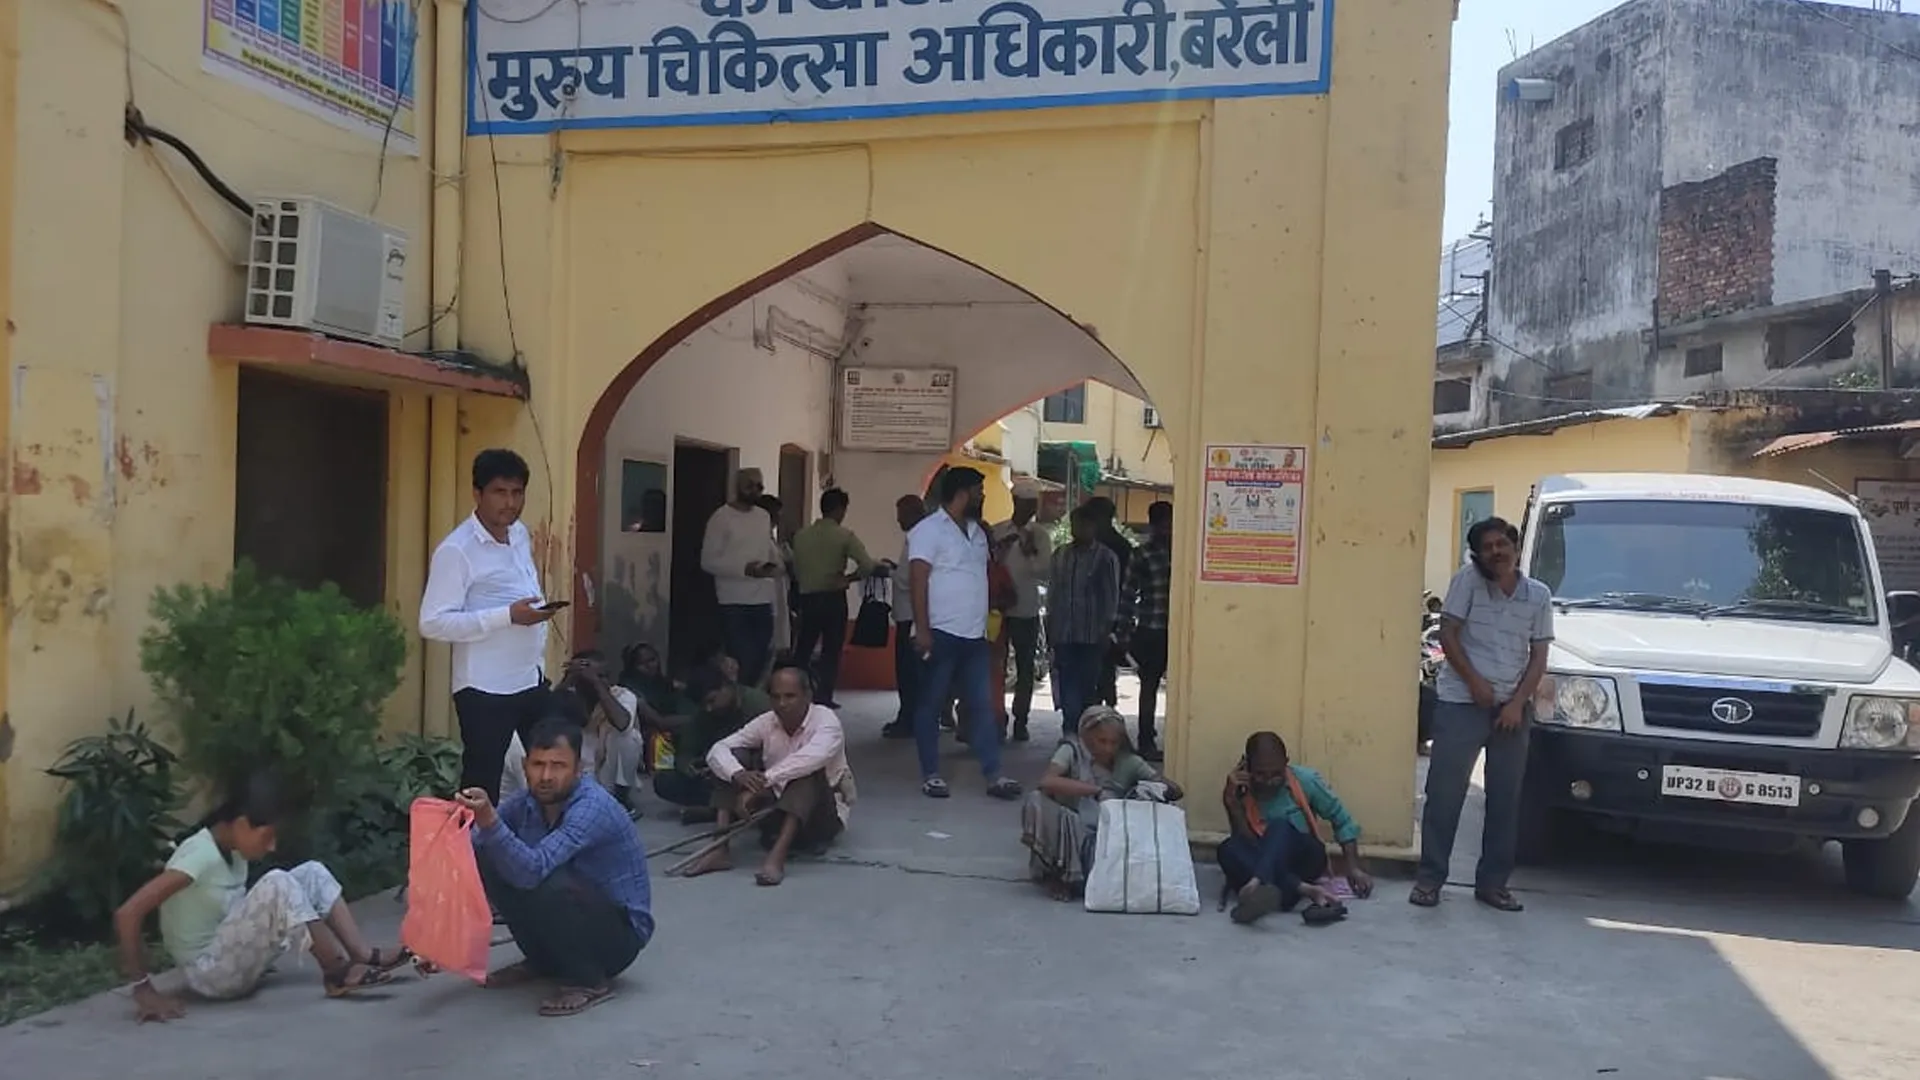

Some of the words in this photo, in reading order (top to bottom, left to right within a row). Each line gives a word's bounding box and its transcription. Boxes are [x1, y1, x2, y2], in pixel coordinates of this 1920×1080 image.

[640, 20, 890, 97] चिकित्सा
[1666, 776, 1703, 791] UP32
[1758, 783, 1793, 799] 8513
